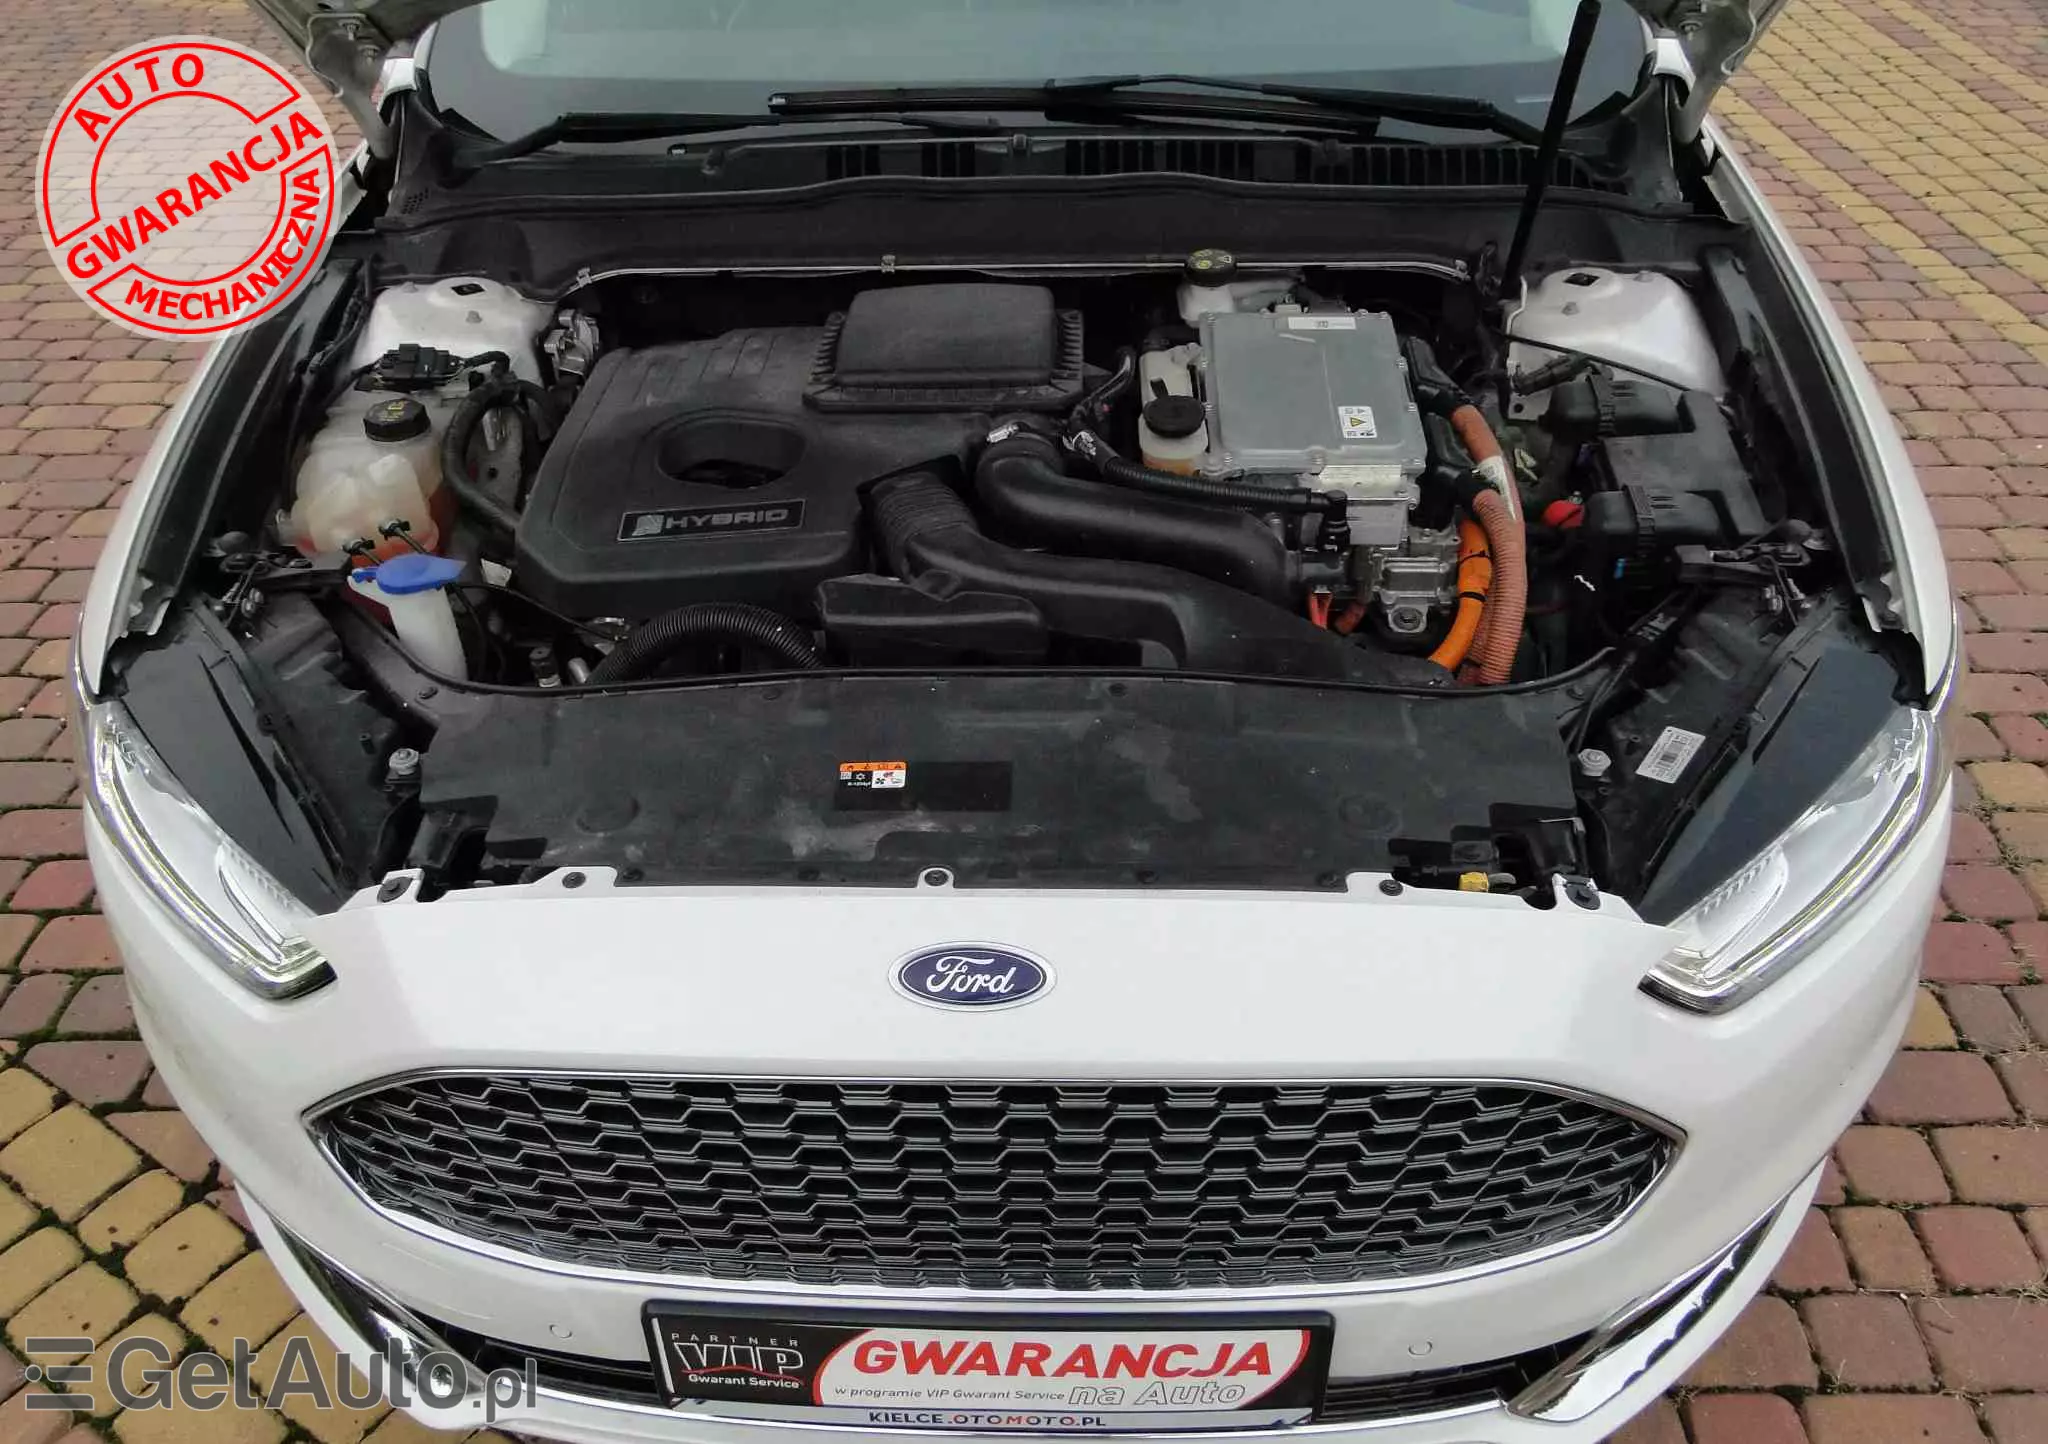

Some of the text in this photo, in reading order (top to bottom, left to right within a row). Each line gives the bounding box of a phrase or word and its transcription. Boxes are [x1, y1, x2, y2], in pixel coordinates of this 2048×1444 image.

[666, 509, 788, 529] HYBRID
[926, 955, 1017, 994] Ford
[671, 1332, 799, 1347] PARTNER
[674, 1342, 804, 1376] VIP
[852, 1340, 1272, 1379] GWARANCJA
[688, 1373, 800, 1389] Gwarant Service
[835, 1387, 1065, 1400] w programie VIP Gwarant Service
[1068, 1381, 1246, 1406] na Auto
